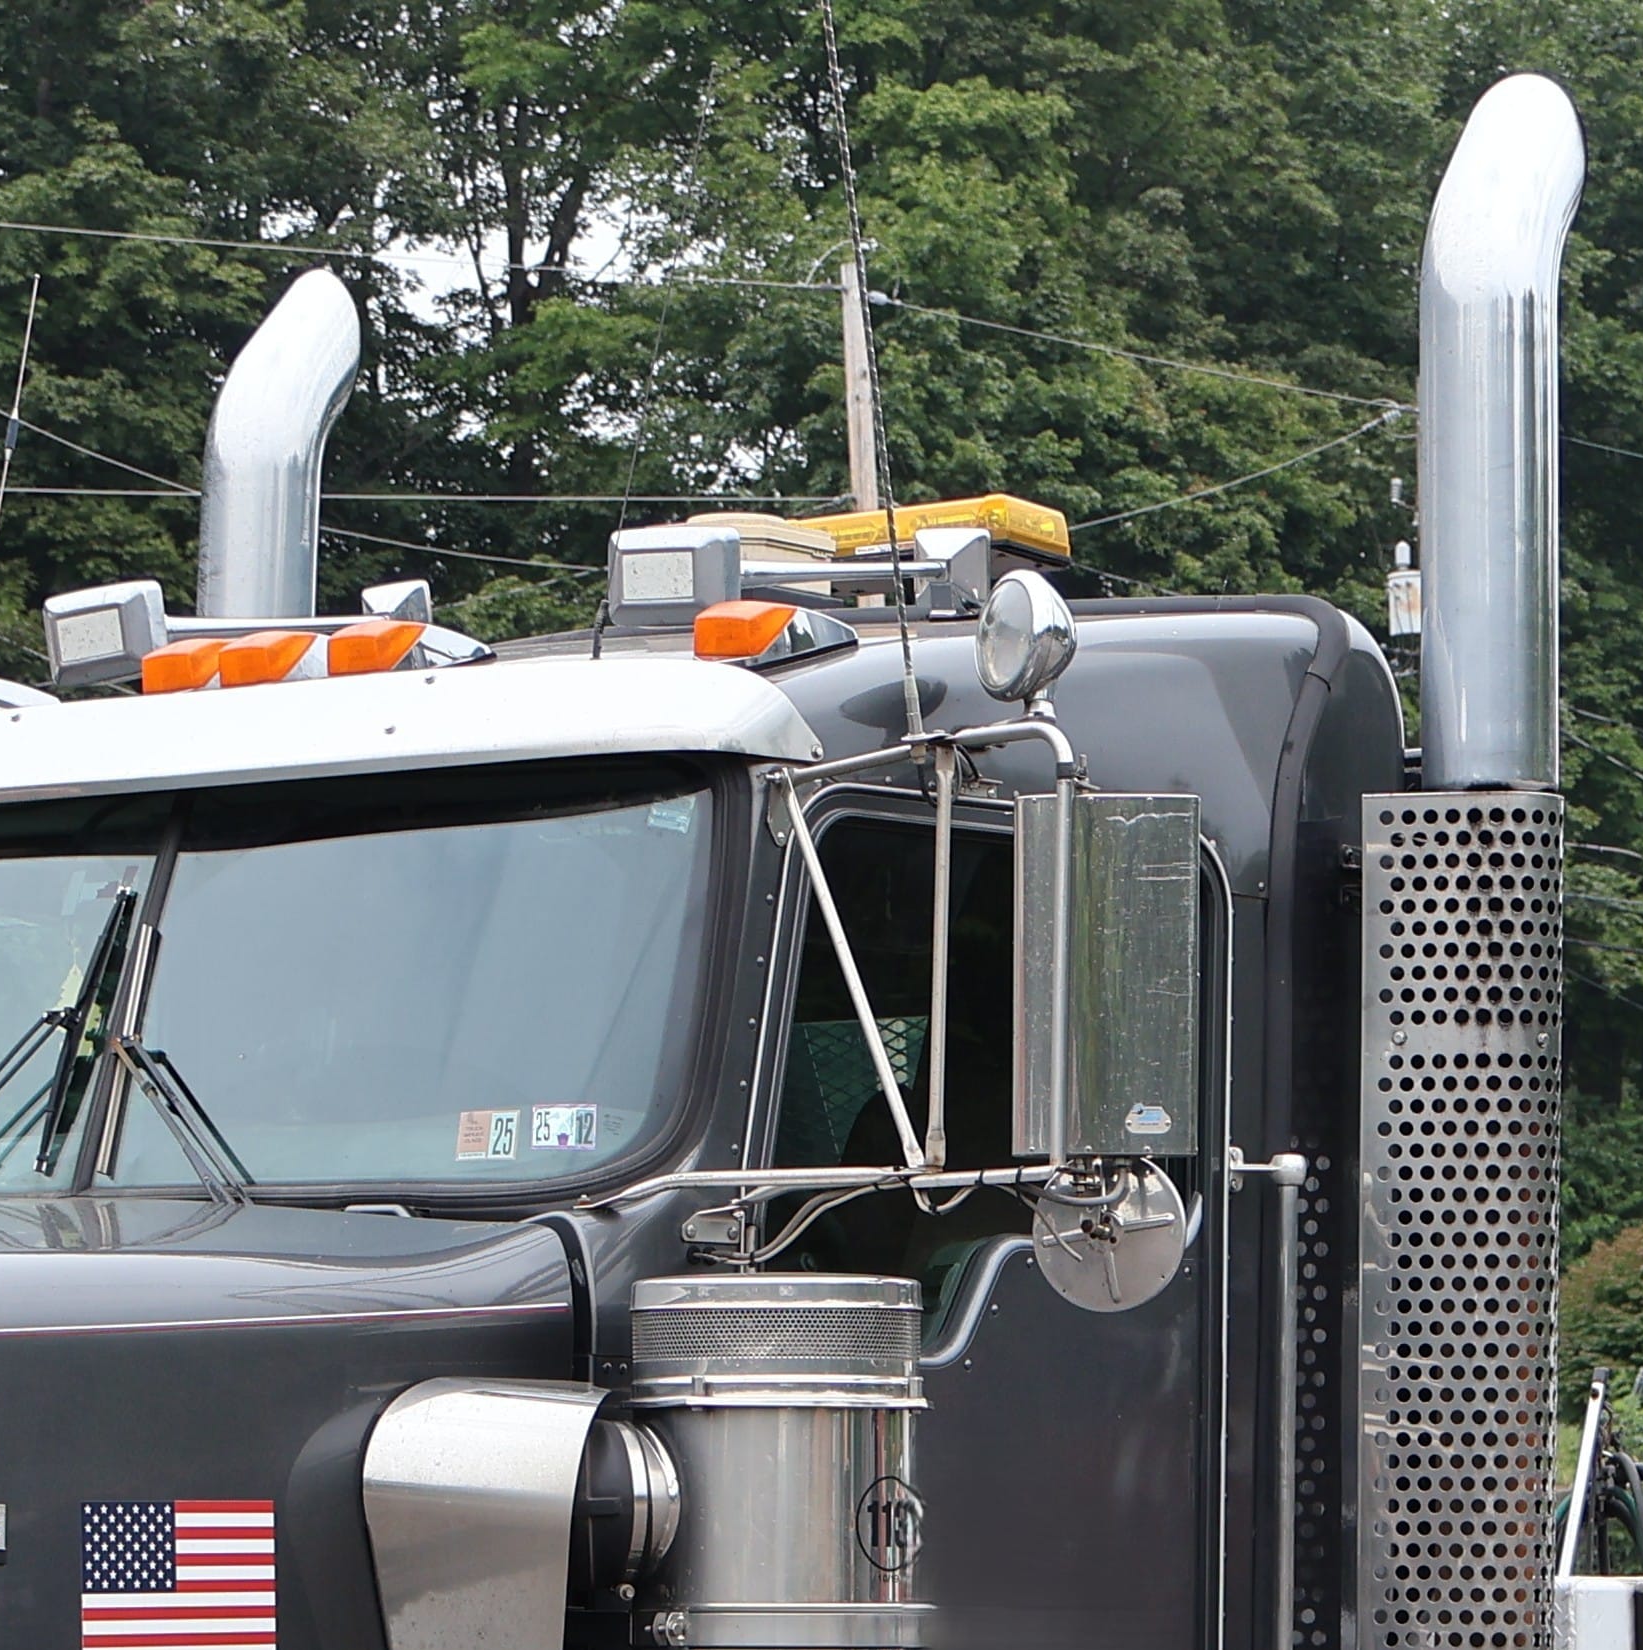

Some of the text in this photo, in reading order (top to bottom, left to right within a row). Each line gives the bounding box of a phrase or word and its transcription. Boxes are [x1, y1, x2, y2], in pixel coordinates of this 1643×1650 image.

[492, 1117, 514, 1156] 25
[536, 1111, 551, 1142] 25
[576, 1112, 595, 1145] 12
